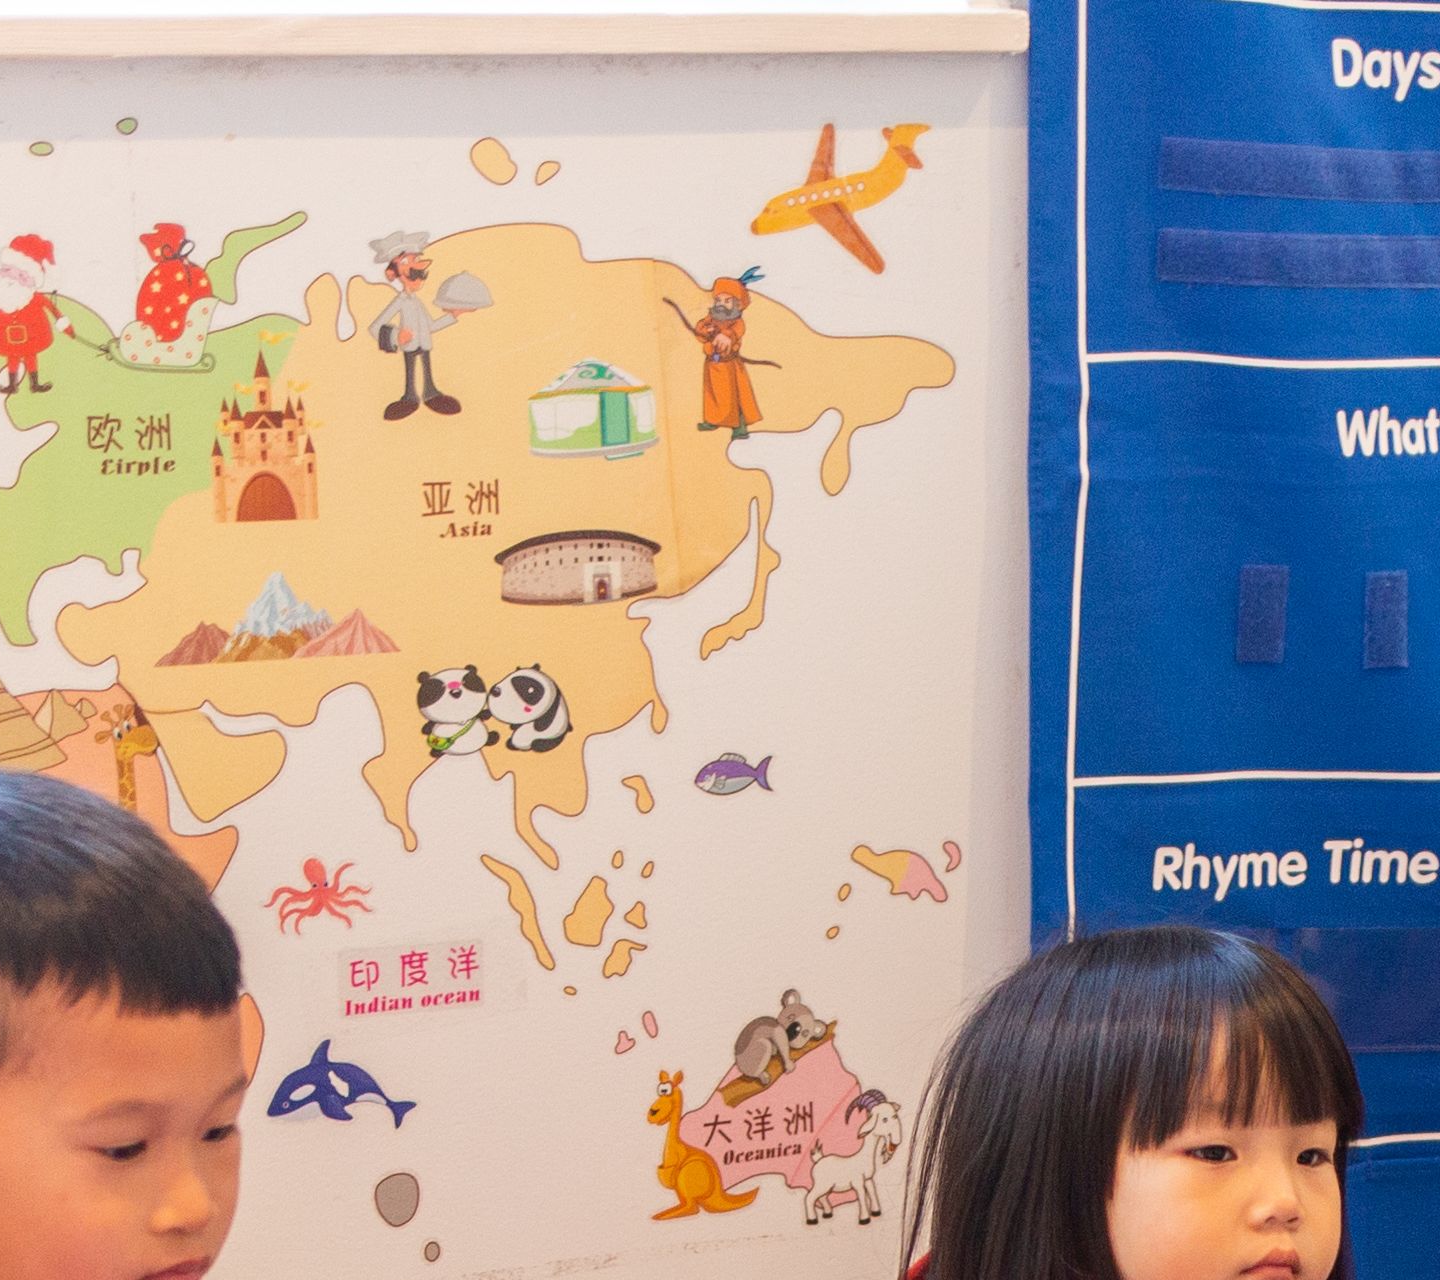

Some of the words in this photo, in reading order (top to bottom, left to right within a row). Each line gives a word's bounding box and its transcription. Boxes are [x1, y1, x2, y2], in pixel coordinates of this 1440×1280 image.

[87, 413, 171, 453] 欧洲
[422, 479, 499, 516] 亚洲
[440, 521, 492, 538] Asia
[1151, 843, 1308, 901] Rhyme
[1322, 838, 1440, 885] Time
[349, 944, 480, 991] 印度洋
[345, 996, 412, 1016] Indian
[420, 989, 480, 1008] ocean
[703, 1101, 814, 1147] 大洋洲
